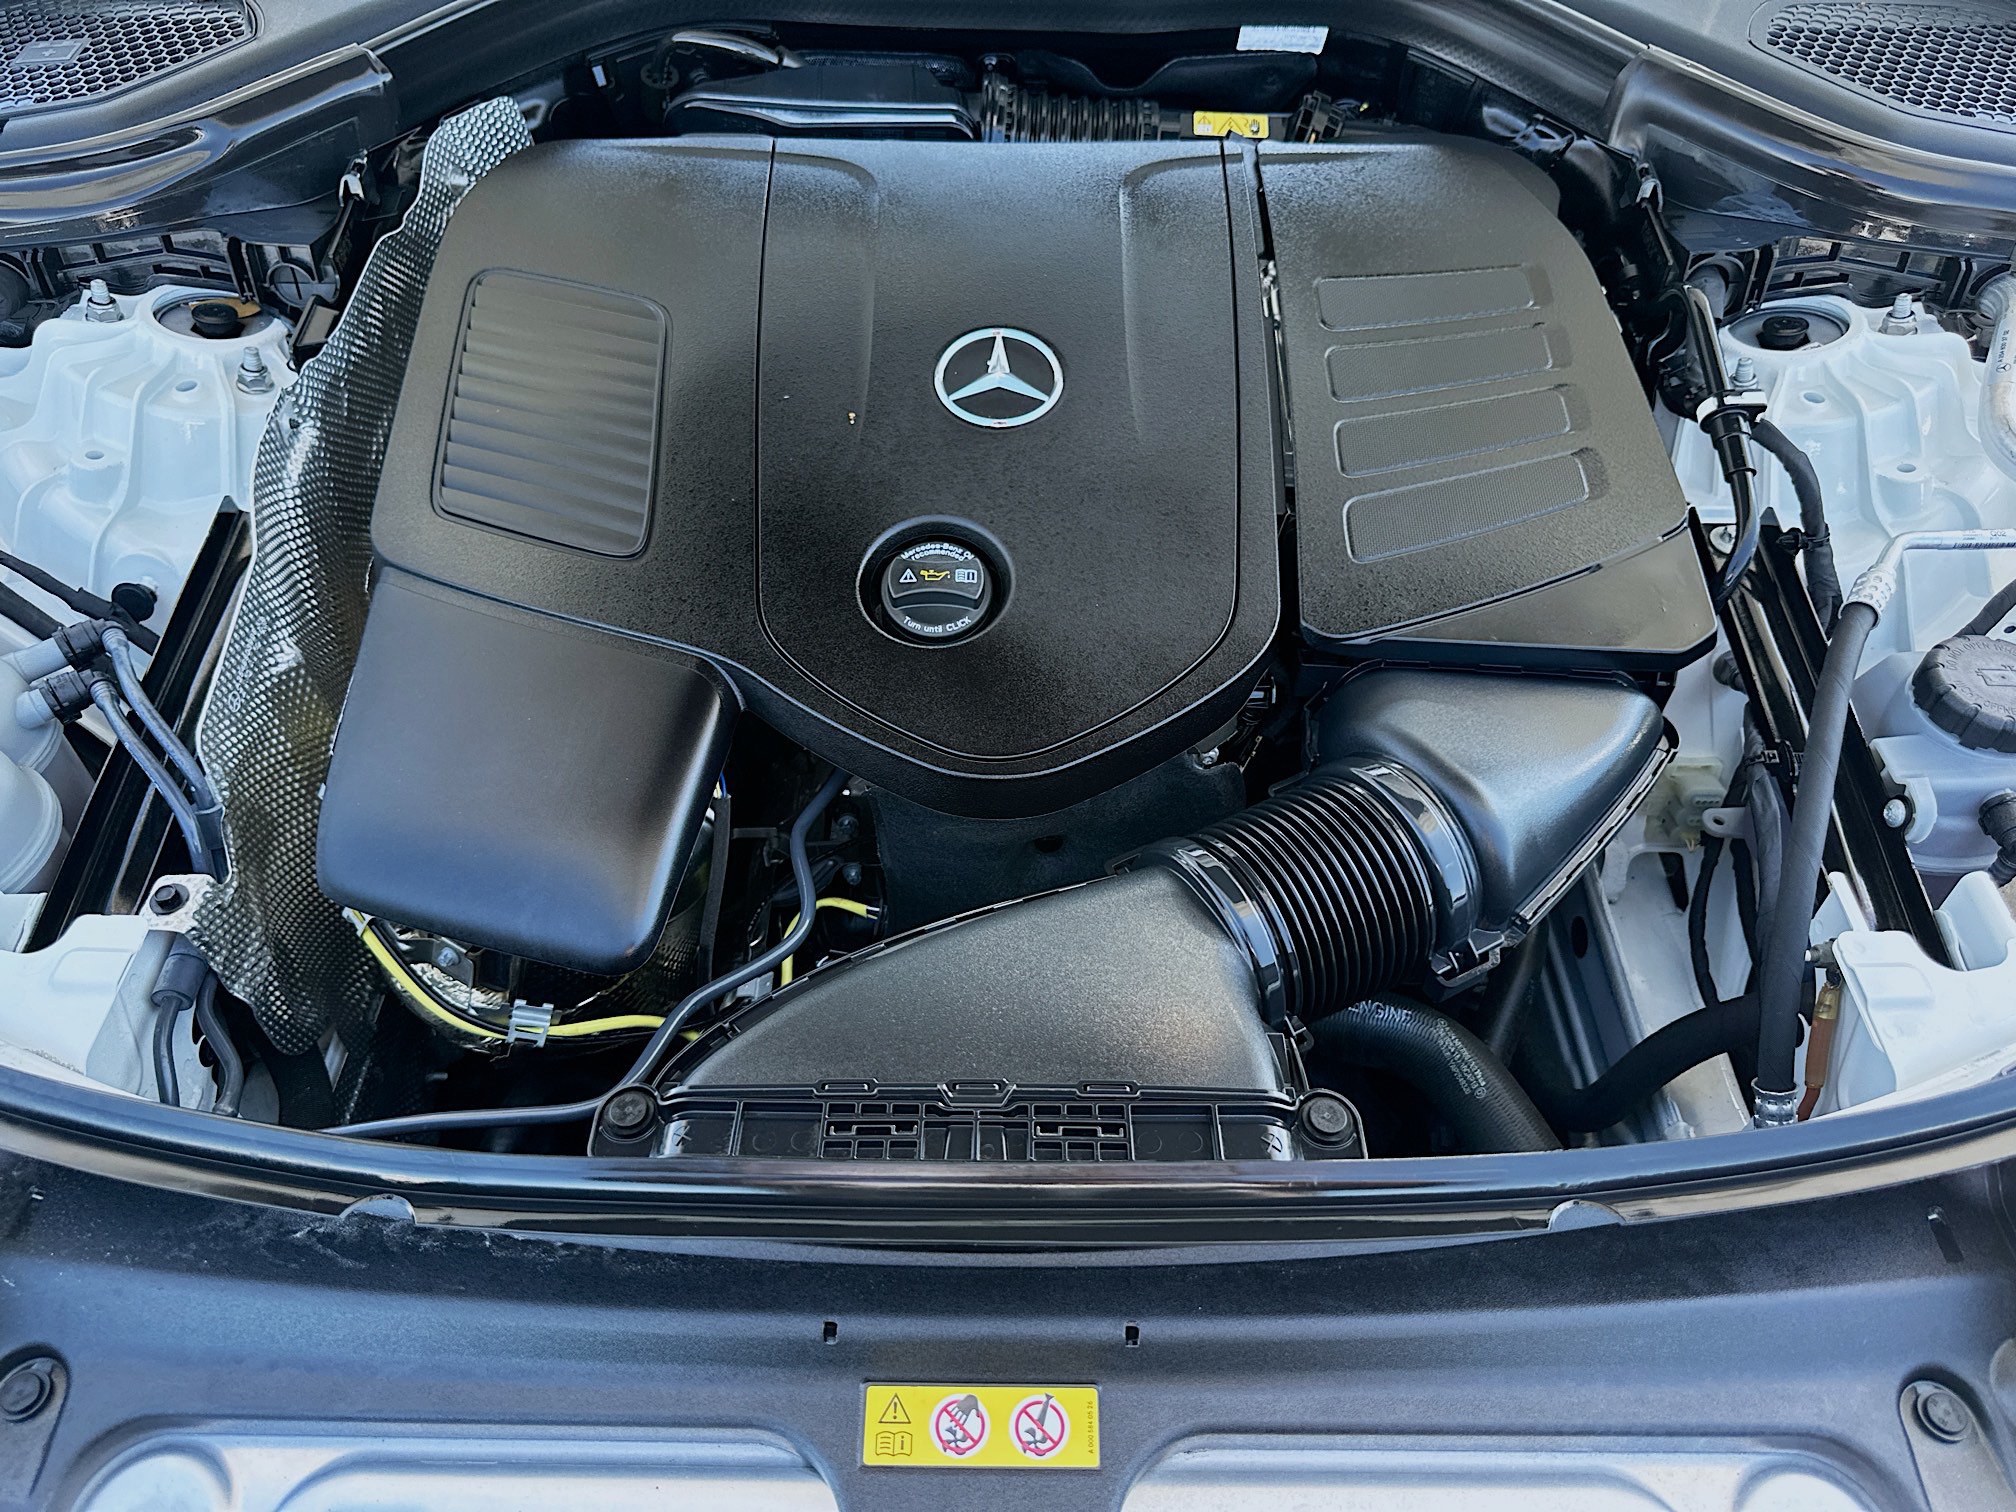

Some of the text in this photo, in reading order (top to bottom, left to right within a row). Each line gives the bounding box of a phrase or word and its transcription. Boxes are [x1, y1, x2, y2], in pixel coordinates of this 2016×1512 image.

[901, 543, 964, 560] Mercedes-Benz
[911, 549, 965, 561] recommended
[903, 615, 972, 633] Turn until CLICK
